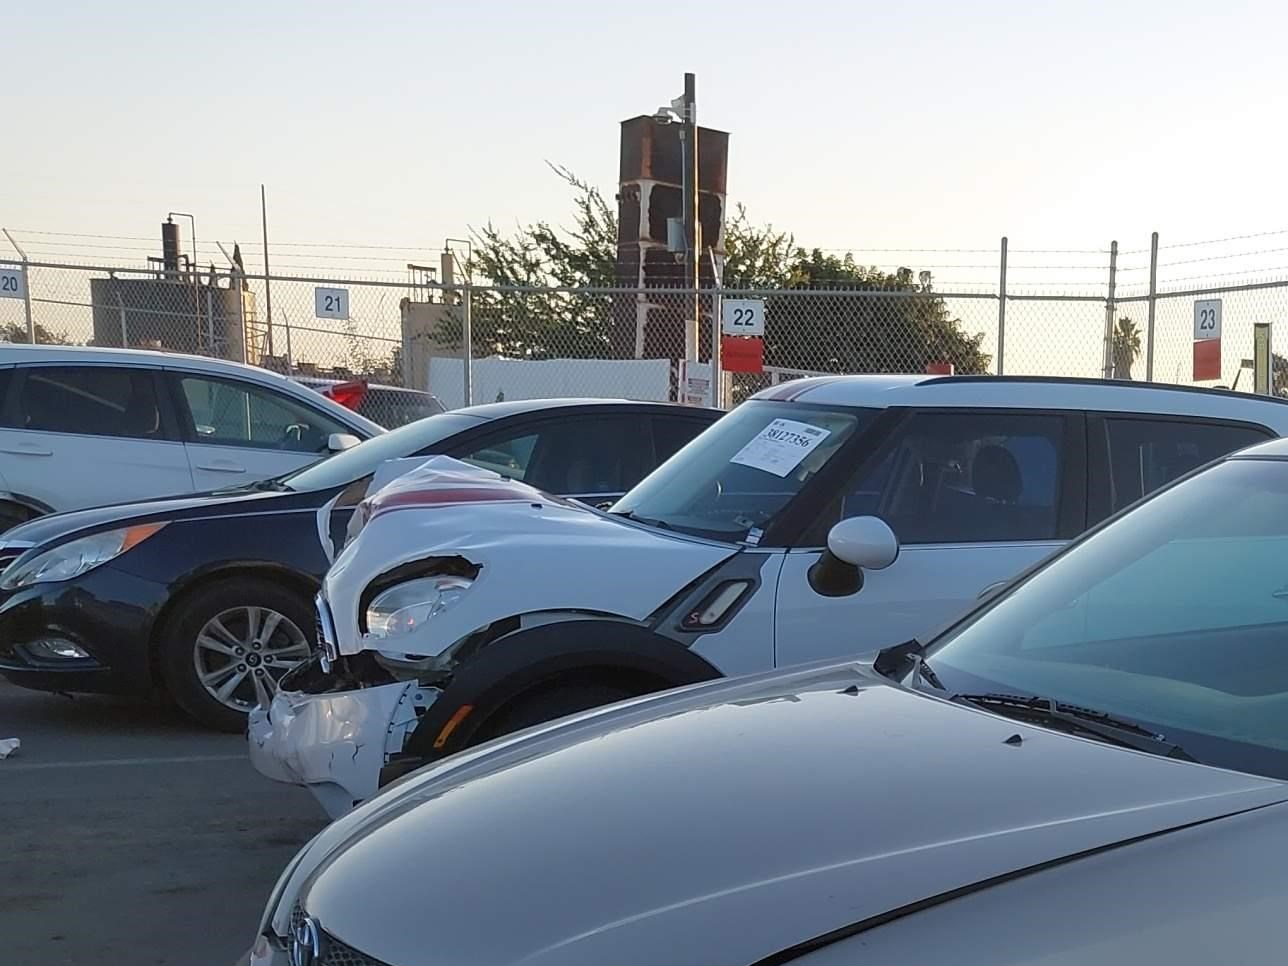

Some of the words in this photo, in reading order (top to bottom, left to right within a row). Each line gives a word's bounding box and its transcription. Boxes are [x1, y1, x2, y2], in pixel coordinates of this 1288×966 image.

[1, 276, 18, 292] 20
[325, 295, 340, 312] 21
[733, 308, 754, 326] 22
[1200, 309, 1216, 330] 23
[767, 428, 811, 447] 38127356
